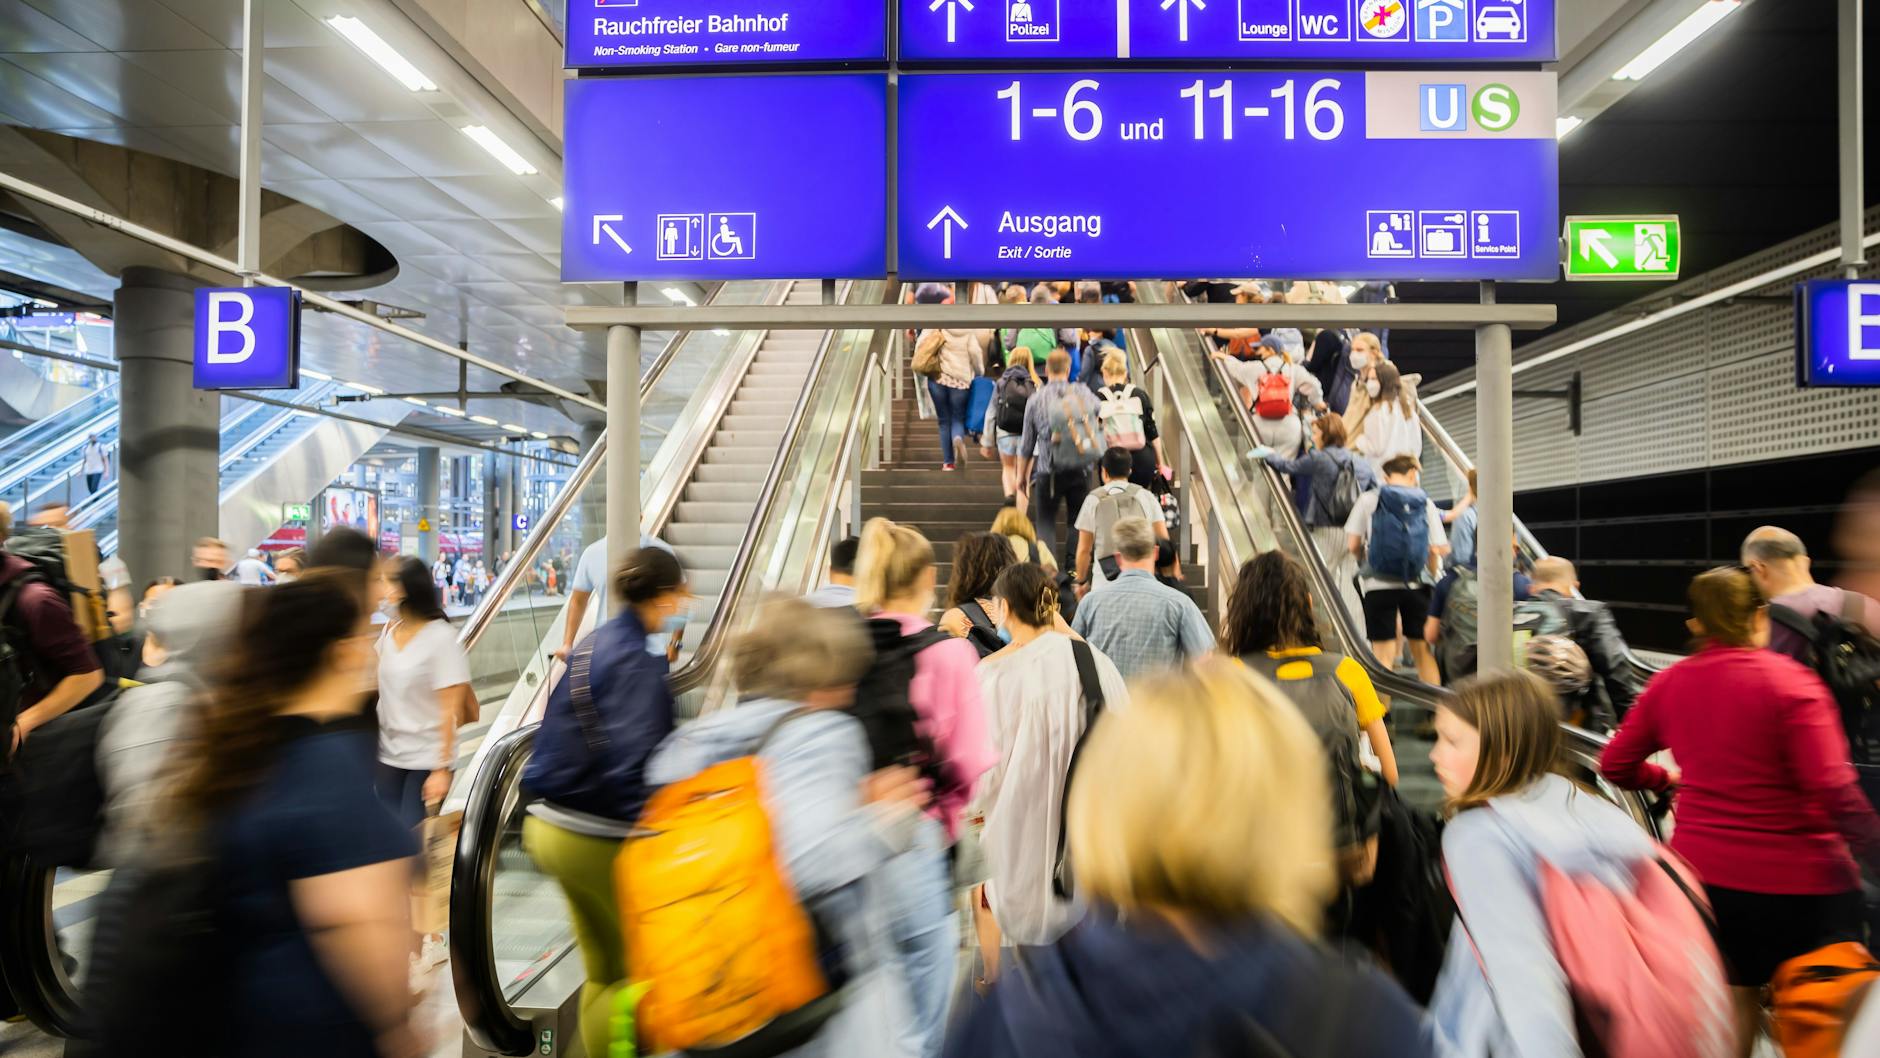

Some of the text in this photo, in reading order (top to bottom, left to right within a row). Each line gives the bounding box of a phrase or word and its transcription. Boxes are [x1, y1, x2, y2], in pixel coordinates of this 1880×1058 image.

[594, 14, 789, 36] Rauchfreier Bahnhof
[1010, 23, 1049, 35] Polizei
[1242, 22, 1288, 37] Lounge
[1301, 15, 1339, 36] WC
[594, 41, 800, 56] Non-Smoking Station Gare non-fumeur
[997, 78, 1344, 141] 1-6 und 11-16
[1428, 87, 1512, 128] U S
[998, 210, 1101, 237] Ausgang
[998, 246, 1022, 258] Exit
[1034, 246, 1072, 258] Sortie
[1475, 245, 1517, 253] Service Point
[207, 292, 256, 364] B
[516, 514, 527, 529] C
